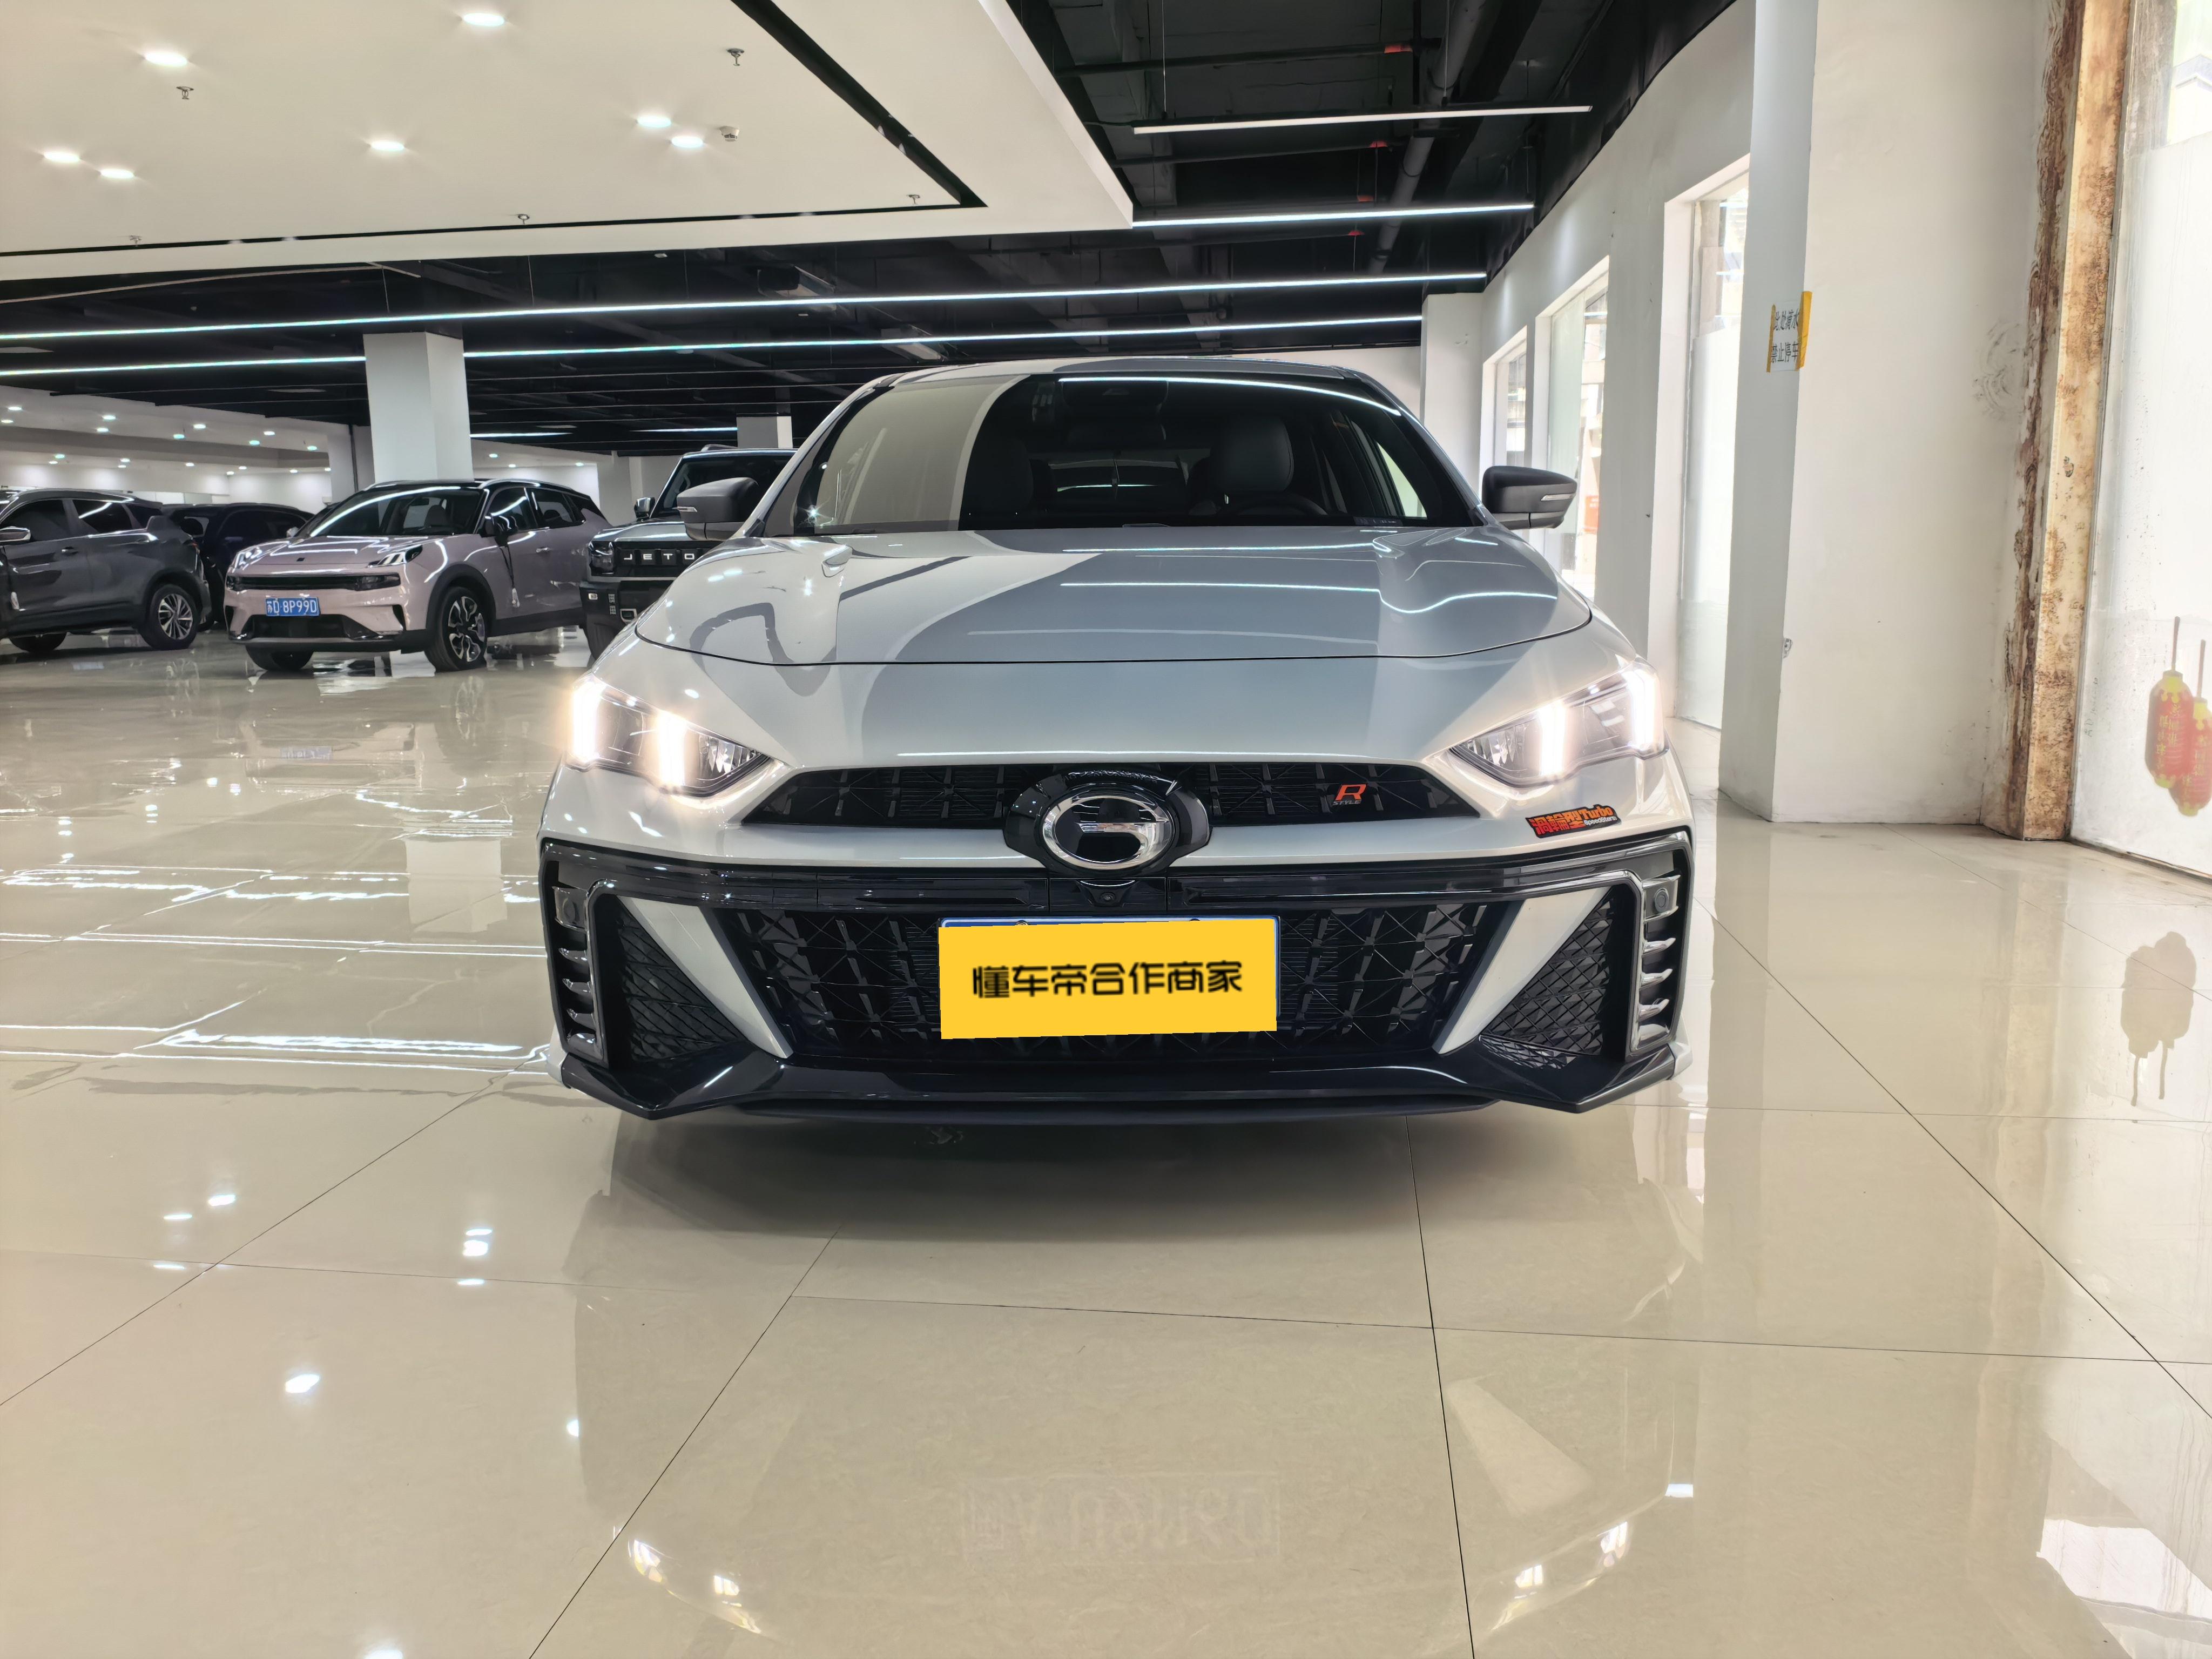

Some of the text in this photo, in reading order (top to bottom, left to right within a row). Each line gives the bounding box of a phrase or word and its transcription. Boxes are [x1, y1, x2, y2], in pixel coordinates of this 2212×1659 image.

[1771, 342, 1800, 363] 禁止停车
[1335, 784, 1366, 801] R
[1580, 806, 1614, 820] Turbo
